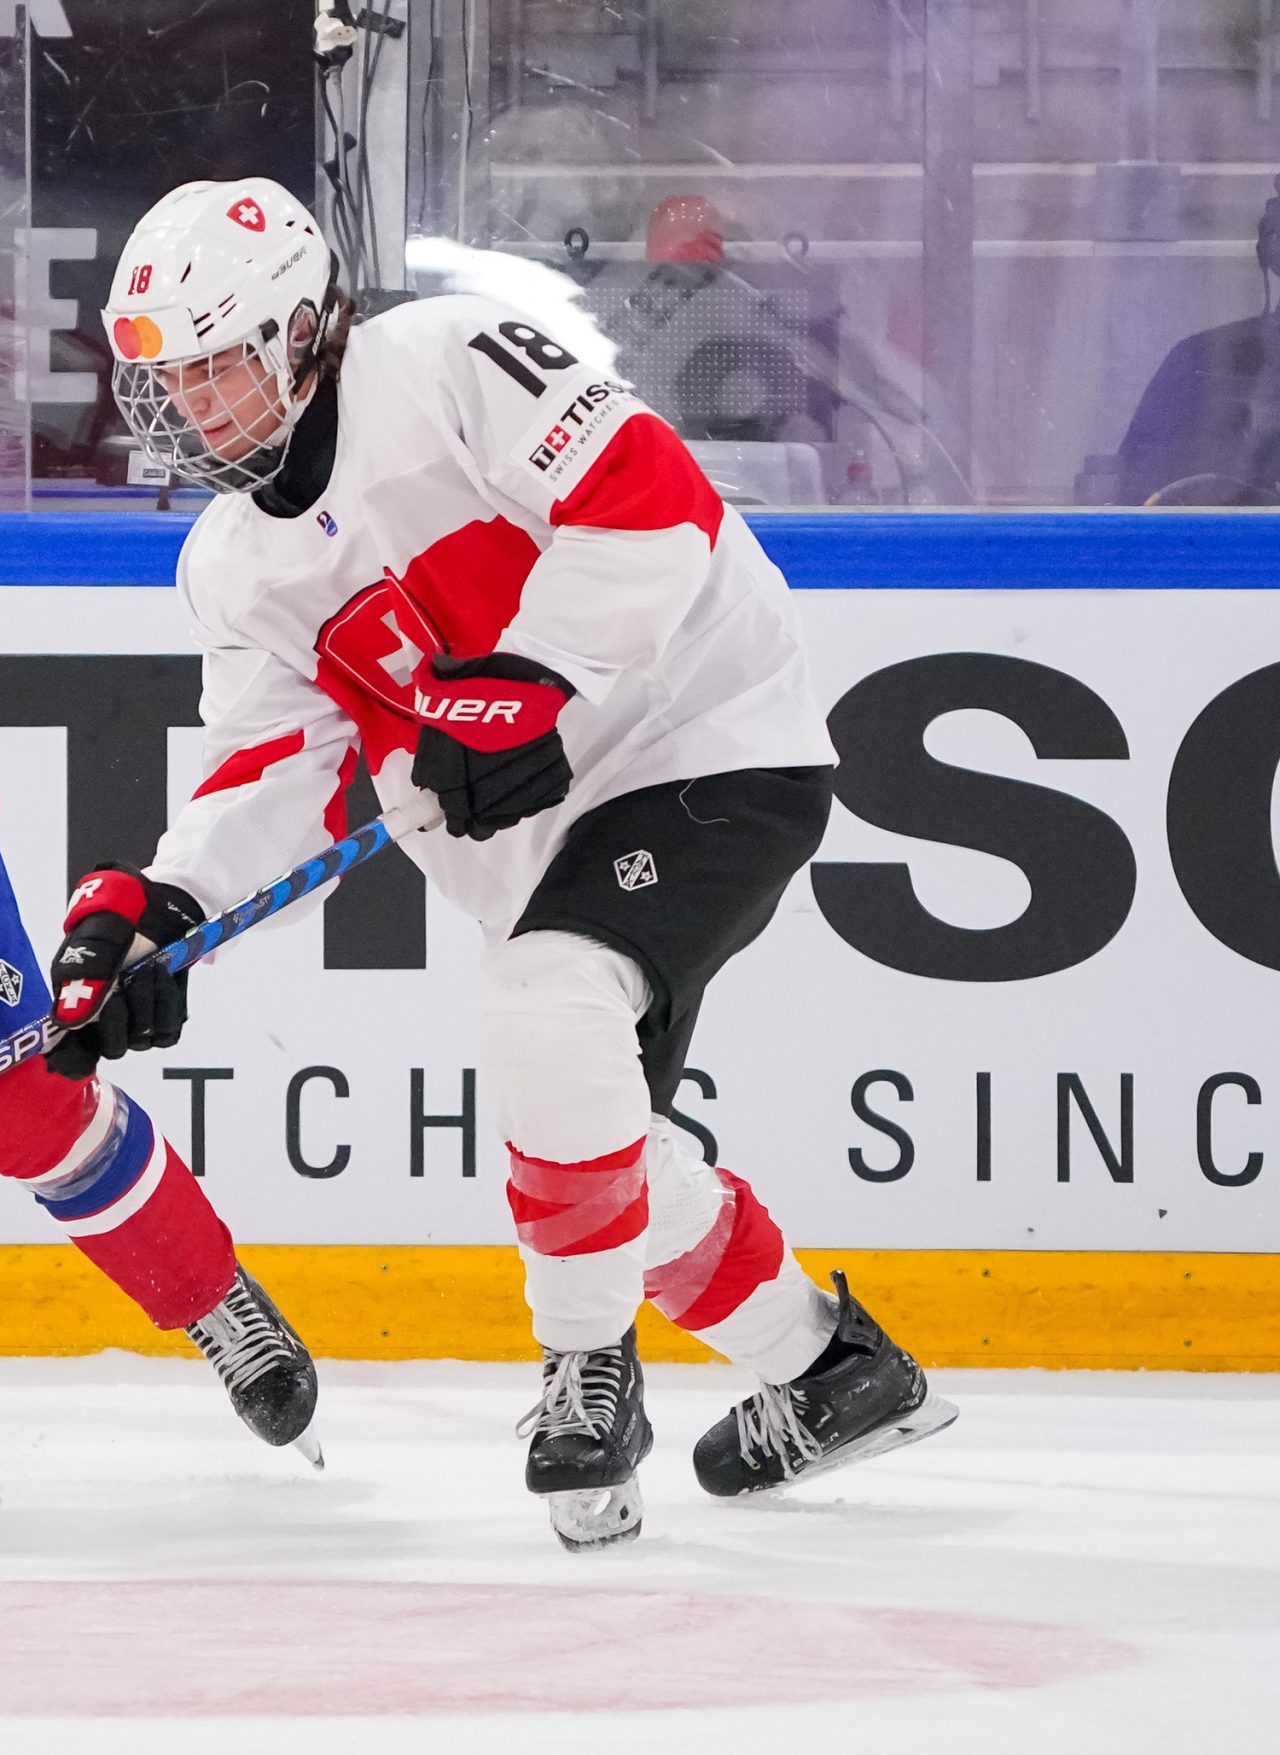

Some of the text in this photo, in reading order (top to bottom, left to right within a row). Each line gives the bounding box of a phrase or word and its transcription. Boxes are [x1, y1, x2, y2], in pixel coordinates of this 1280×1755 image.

[128, 264, 152, 295] 18
[467, 321, 579, 399] 18
[560, 381, 637, 426] TISS
[549, 448, 578, 482] SWISS
